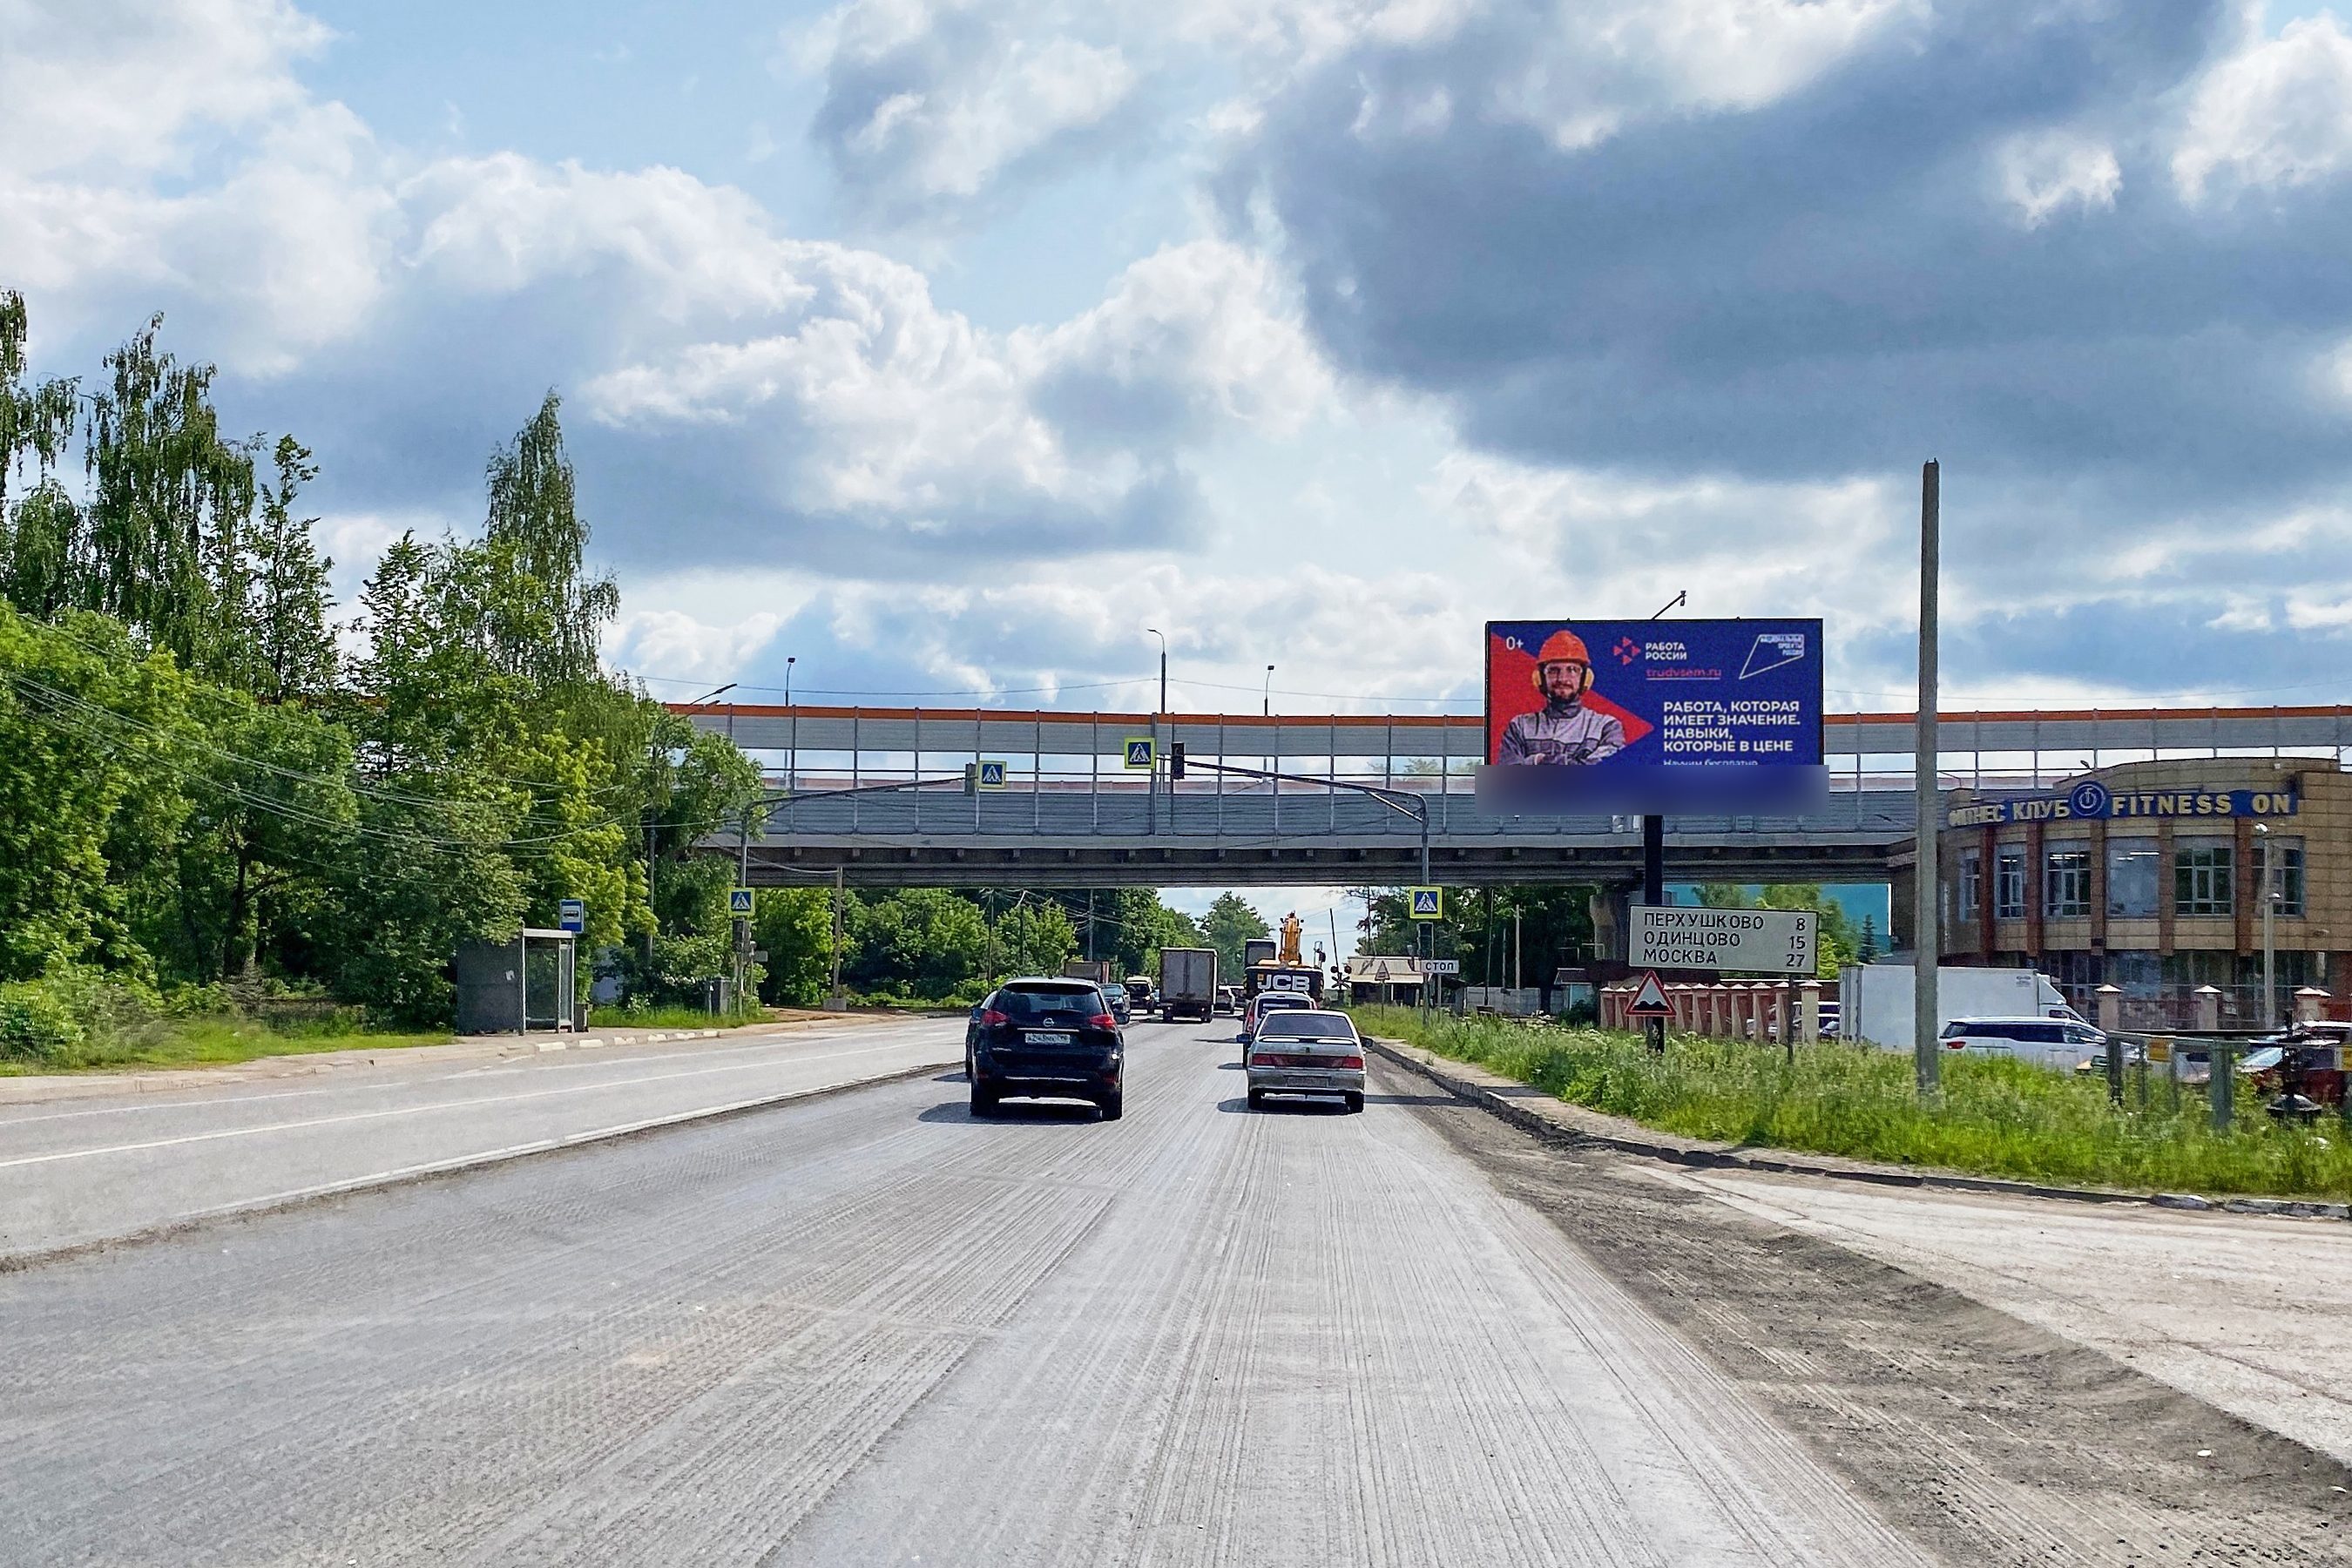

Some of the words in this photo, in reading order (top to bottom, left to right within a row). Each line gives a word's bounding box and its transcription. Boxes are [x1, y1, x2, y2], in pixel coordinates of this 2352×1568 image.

[1506, 636, 1524, 651] 0+
[1645, 642, 1686, 651] РАБОТА
[1645, 652, 1687, 660] РОССИИ
[1646, 667, 1722, 677] trudvsem.ru
[1663, 701, 1727, 713] РАБОТА,
[1731, 700, 1800, 712] КОТОРАЯ
[1663, 714, 1714, 726] ИМЕЕТ
[1717, 713, 1801, 726] ЗНАЧЕНИЕ.
[1663, 727, 1734, 740] НАВЫКИ,
[1663, 740, 1736, 752] КОТОРЫЕ
[1740, 740, 1749, 752] В
[1754, 740, 1794, 754] ЦЕНЕ
[2013, 799, 2071, 821] КЛУБ
[2111, 792, 2233, 816] FITNESS
[2251, 794, 2290, 814] ON
[1644, 912, 1764, 929] ПЕРХУШКОВО
[1795, 917, 1806, 931] 8
[1644, 931, 1740, 947] ОДИНЦОВО
[1789, 935, 1806, 950] 15
[1643, 949, 1718, 964] МОСКВА
[1786, 954, 1806, 967] 27
[1425, 962, 1454, 970] СТОП
[1257, 974, 1310, 991] JCB
